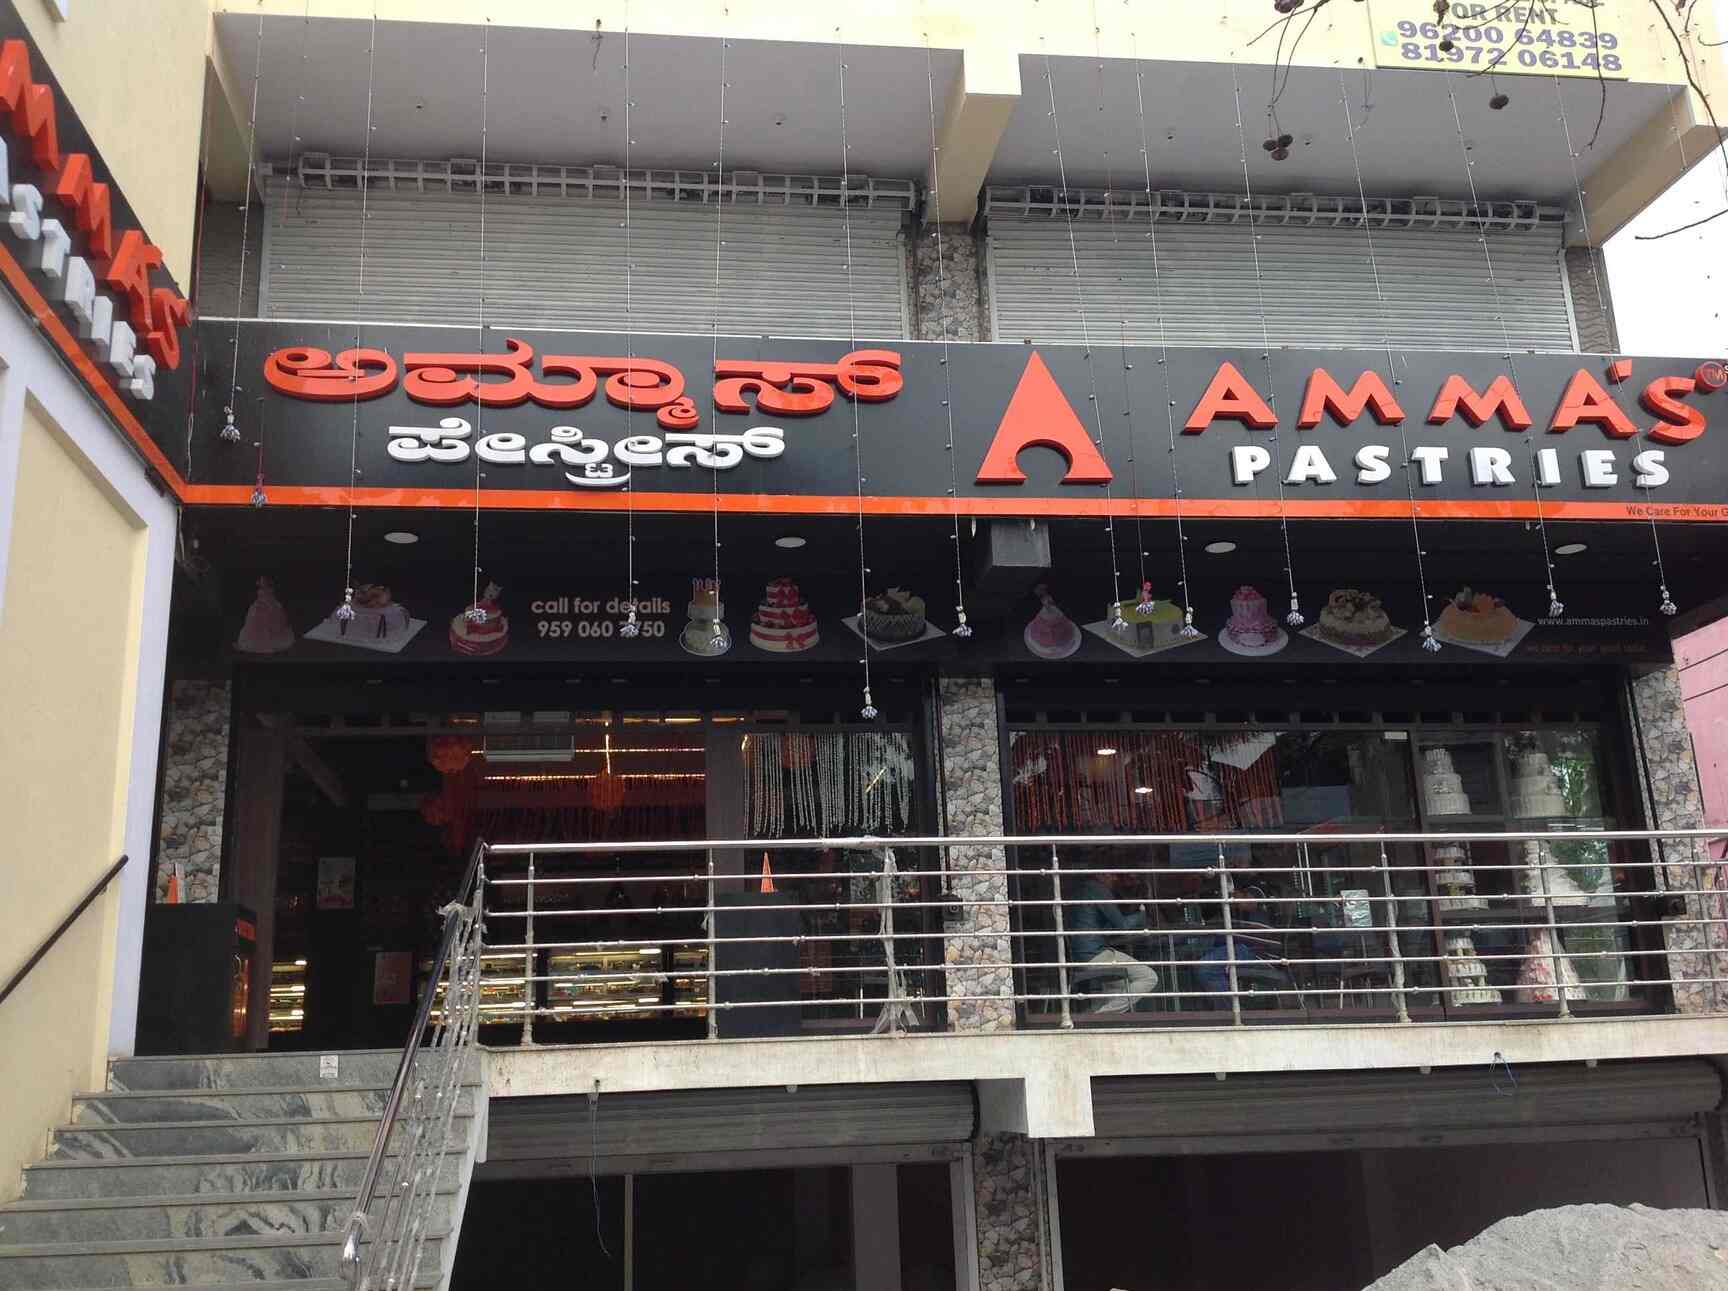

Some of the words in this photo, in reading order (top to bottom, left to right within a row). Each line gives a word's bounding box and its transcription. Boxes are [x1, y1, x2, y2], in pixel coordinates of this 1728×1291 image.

[1440, 2, 1488, 21] OR
[1494, 6, 1559, 25] RENT
[1397, 20, 1504, 44] 96200
[1514, 28, 1618, 51] 64839
[1401, 42, 1507, 66] 81972
[1518, 50, 1622, 72] 06148
[1181, 359, 1706, 443] AMMA'S
[1232, 445, 1670, 488] PASTRIES
[1626, 504, 1644, 516] We
[1694, 507, 1718, 518] Your
[531, 598, 569, 614] call
[573, 598, 601, 614] for
[537, 621, 573, 638] 959
[577, 621, 614, 638] 060
[1537, 617, 1649, 628] www.ammaspastries.in
